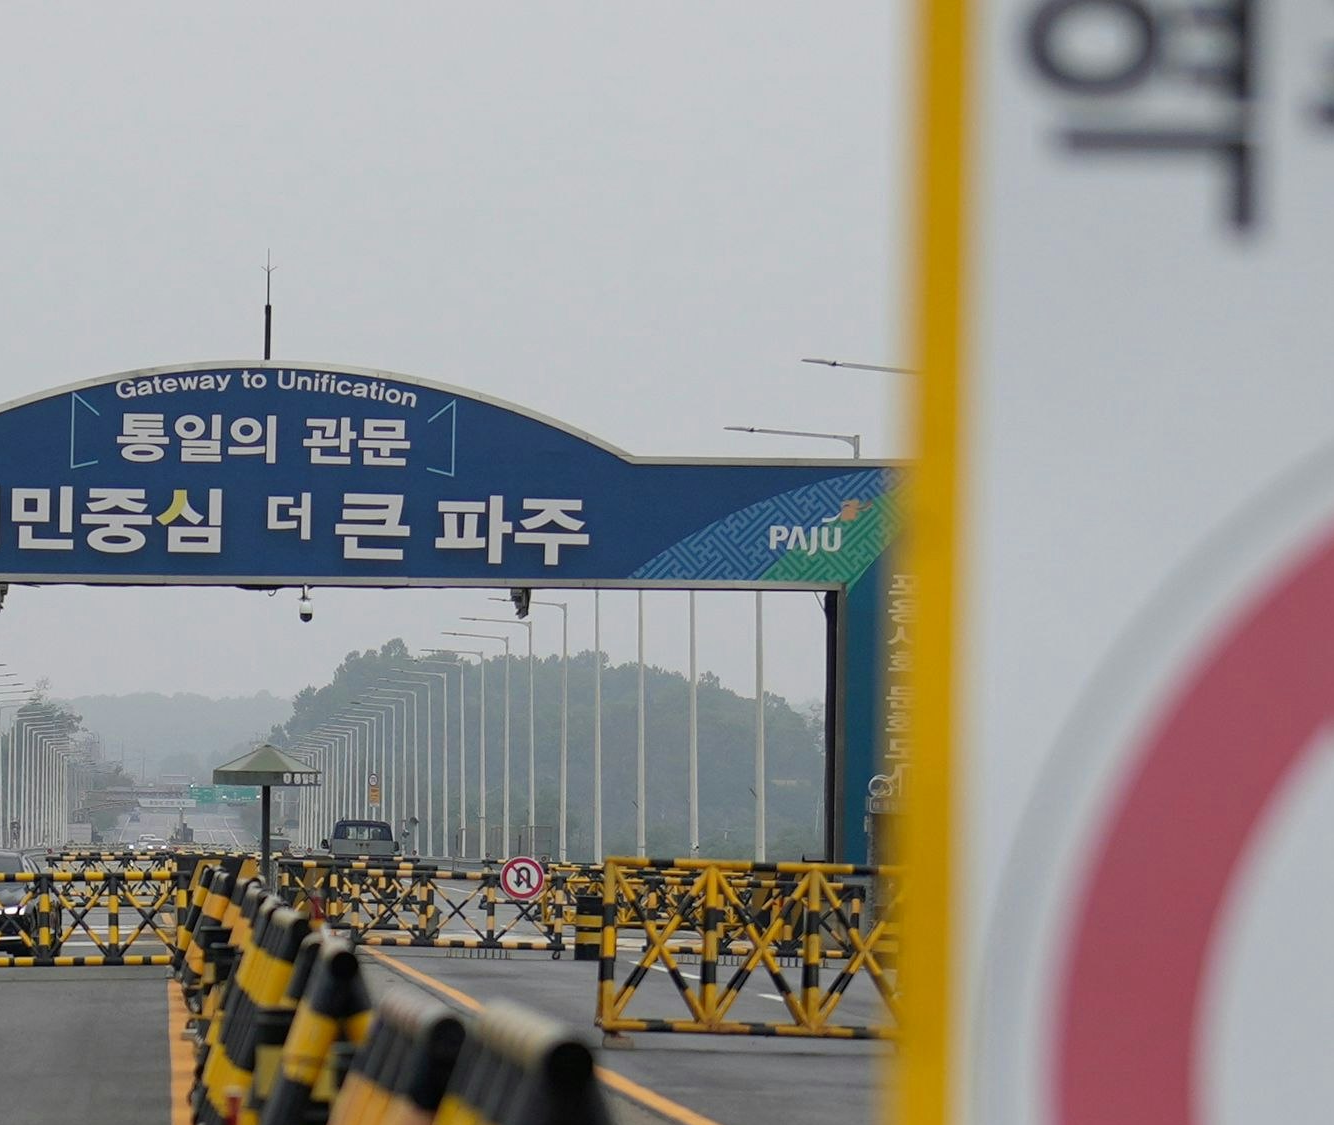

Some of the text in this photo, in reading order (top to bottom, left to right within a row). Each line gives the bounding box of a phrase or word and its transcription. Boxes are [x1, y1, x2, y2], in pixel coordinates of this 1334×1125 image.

[115, 369, 417, 408] Gateway to Unification
[116, 412, 411, 467] 통일의 관문
[266, 491, 312, 541] 더
[334, 492, 411, 561] 큰
[434, 494, 590, 566] 파주
[769, 525, 842, 556] PAJU
